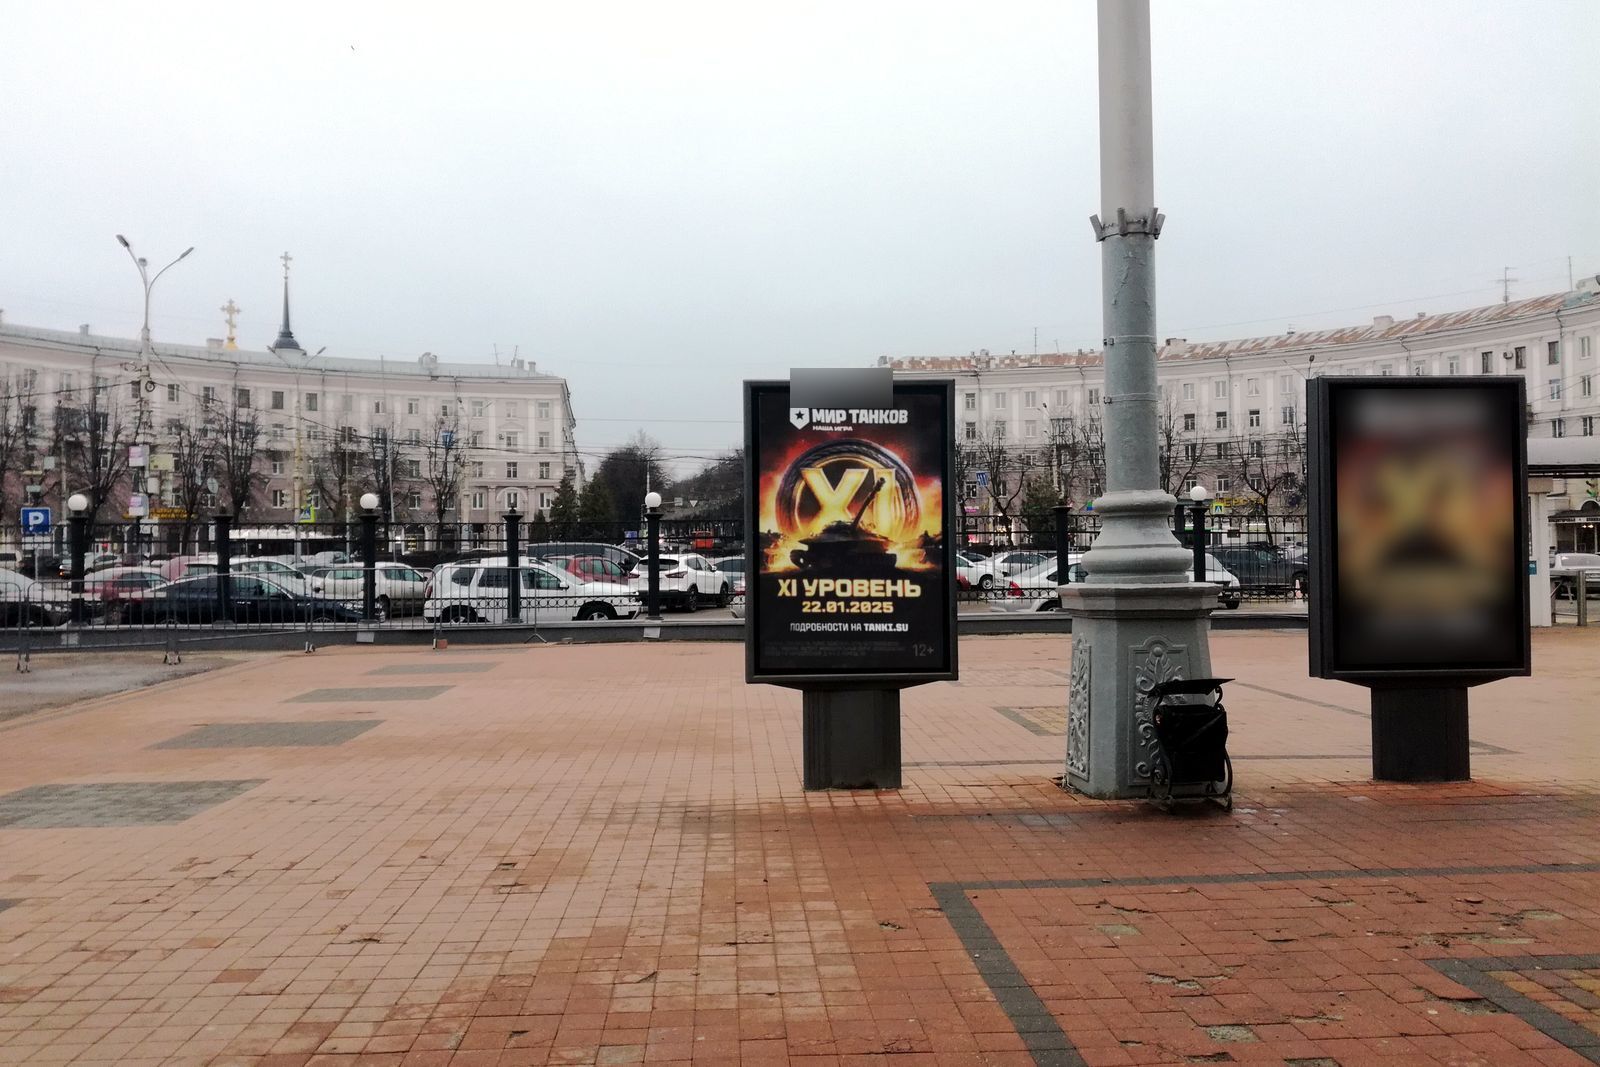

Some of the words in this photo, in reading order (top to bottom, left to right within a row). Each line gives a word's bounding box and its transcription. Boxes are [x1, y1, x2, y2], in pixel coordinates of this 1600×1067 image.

[812, 408, 847, 424] МИР
[848, 409, 909, 424] ТАНКОВ
[800, 468, 896, 540] XI
[28, 511, 44, 531] P
[777, 578, 798, 597] XI
[802, 578, 922, 598] УРОВЕНЬ
[802, 601, 894, 613] 22.01.2025
[790, 622, 849, 632] ПОДРОБНОСТИ
[851, 623, 862, 632] НА
[863, 623, 909, 632] TANKI.SU
[912, 644, 935, 657] 12+
